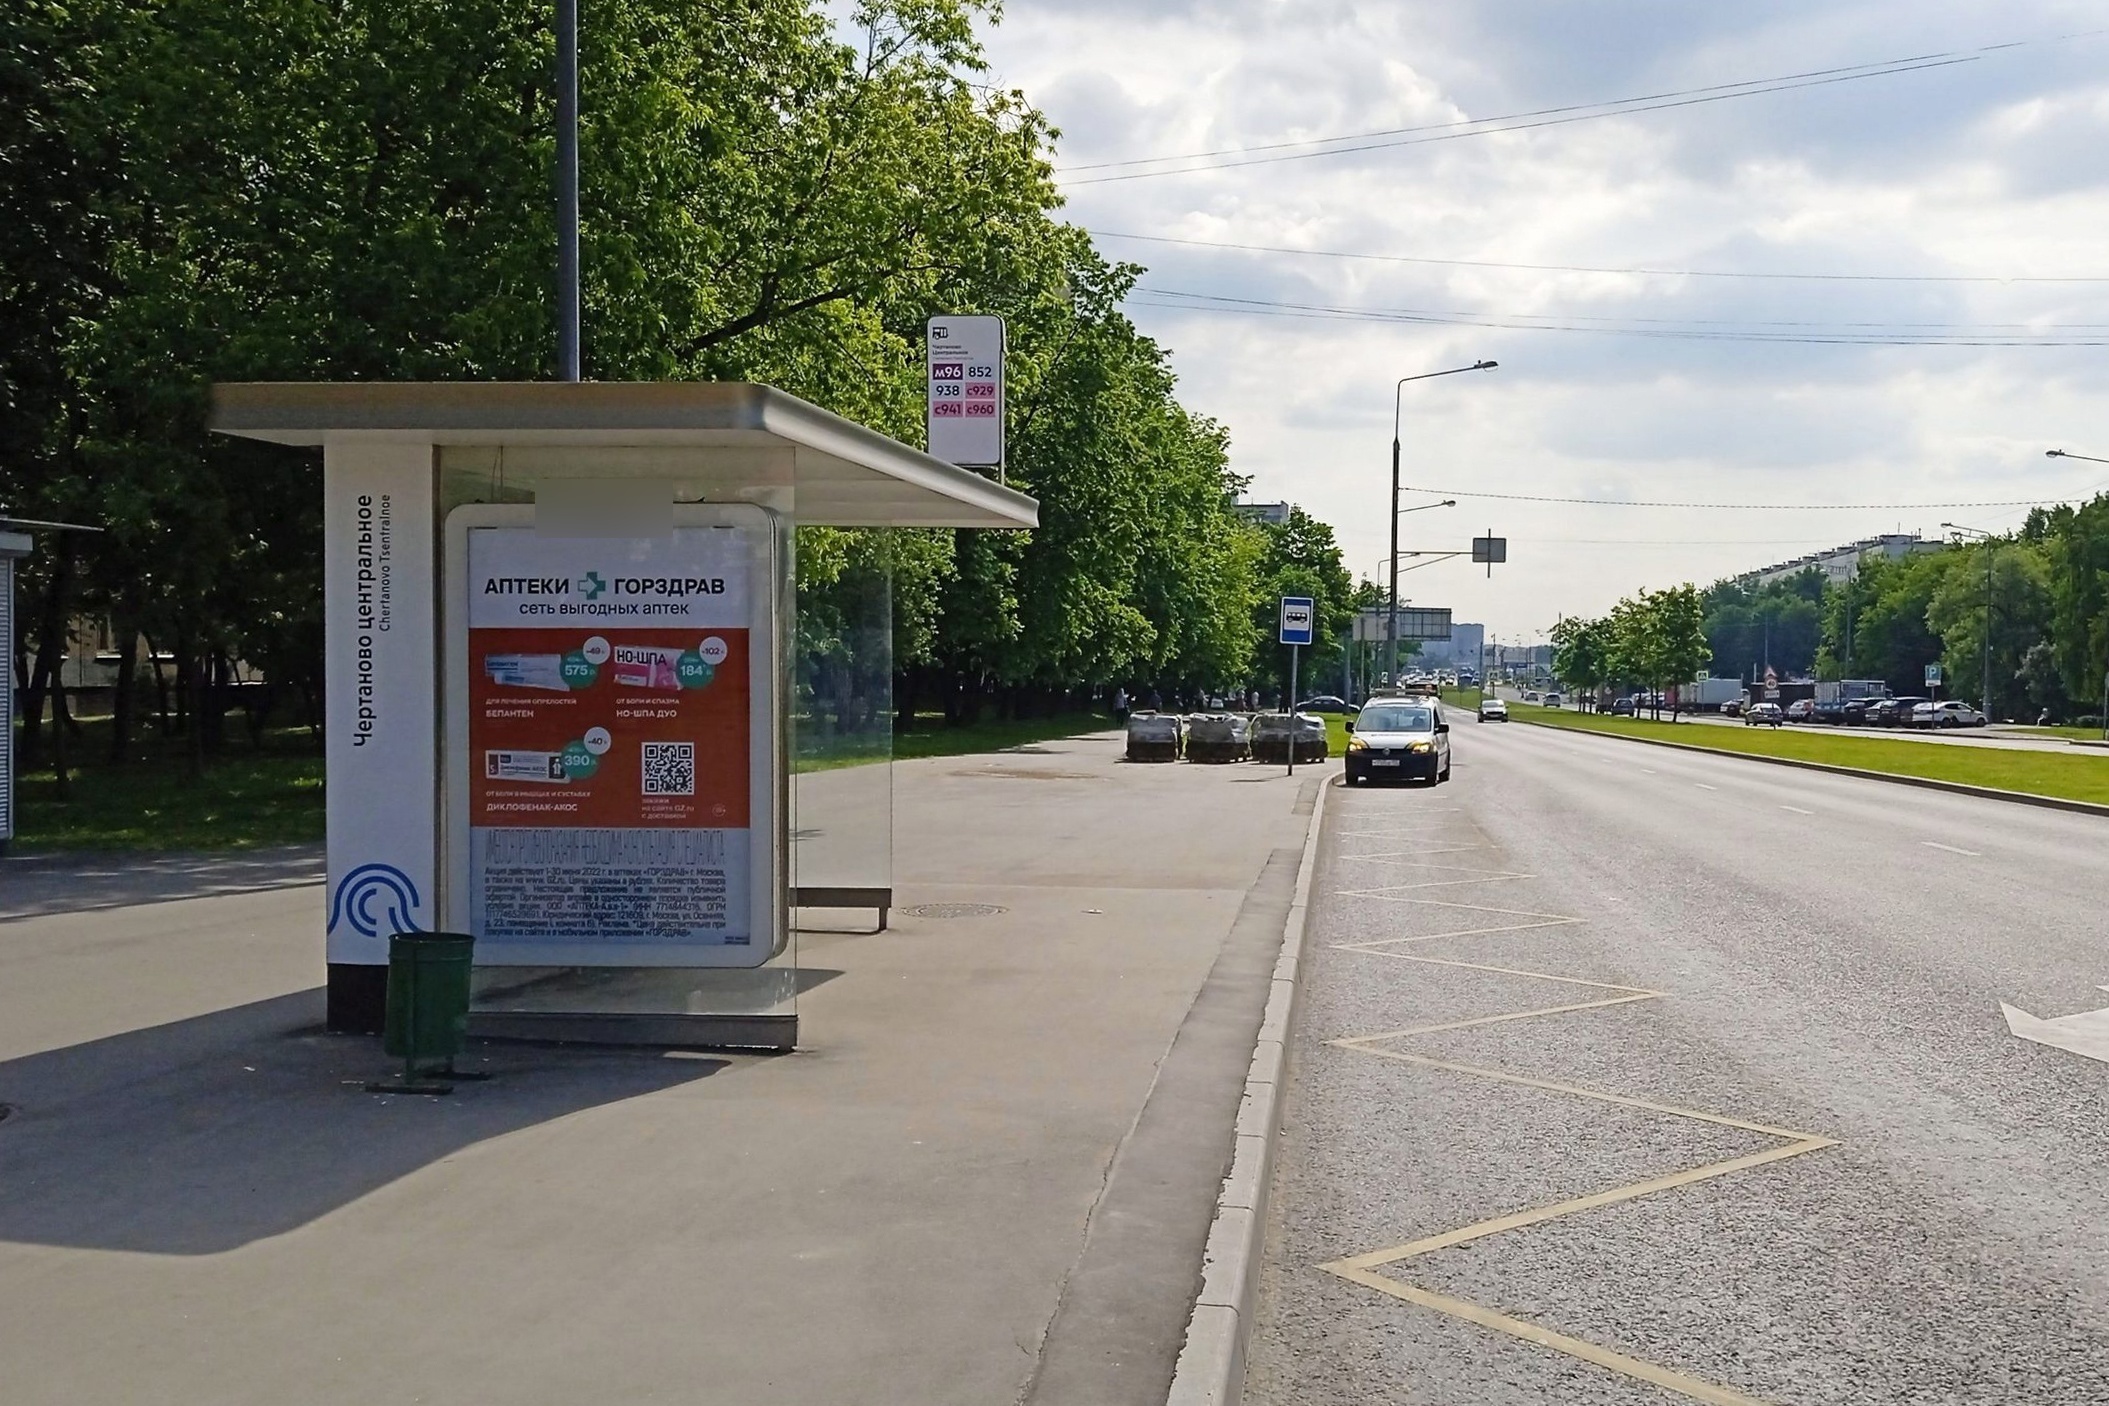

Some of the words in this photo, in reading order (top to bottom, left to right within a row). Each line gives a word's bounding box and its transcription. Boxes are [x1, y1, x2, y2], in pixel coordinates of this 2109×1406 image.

[934, 366, 961, 378] м96
[968, 366, 992, 378] 852
[936, 385, 960, 396] 938
[966, 385, 994, 396] с929
[934, 404, 961, 415] с941
[966, 404, 994, 415] с960
[379, 494, 391, 562] Tsentralnoe
[357, 494, 376, 629] центральное
[484, 578, 569, 595] АПТЕКИ
[614, 578, 725, 597] ГОРЗДРАВ
[379, 565, 391, 632] Chertanovo
[519, 603, 555, 615] сеть
[559, 603, 639, 616] выгодных
[642, 603, 689, 616] аптек
[616, 649, 668, 666] НО-ШПА
[564, 664, 588, 676] 575
[353, 635, 377, 747] Чертаново
[485, 709, 535, 718] БЕПАНТЕН
[616, 709, 656, 718] НО-ШПА
[656, 709, 678, 718] ДУО
[564, 755, 590, 766] 390
[486, 803, 578, 812] ДИКЛОФЕНАК-АКОС
